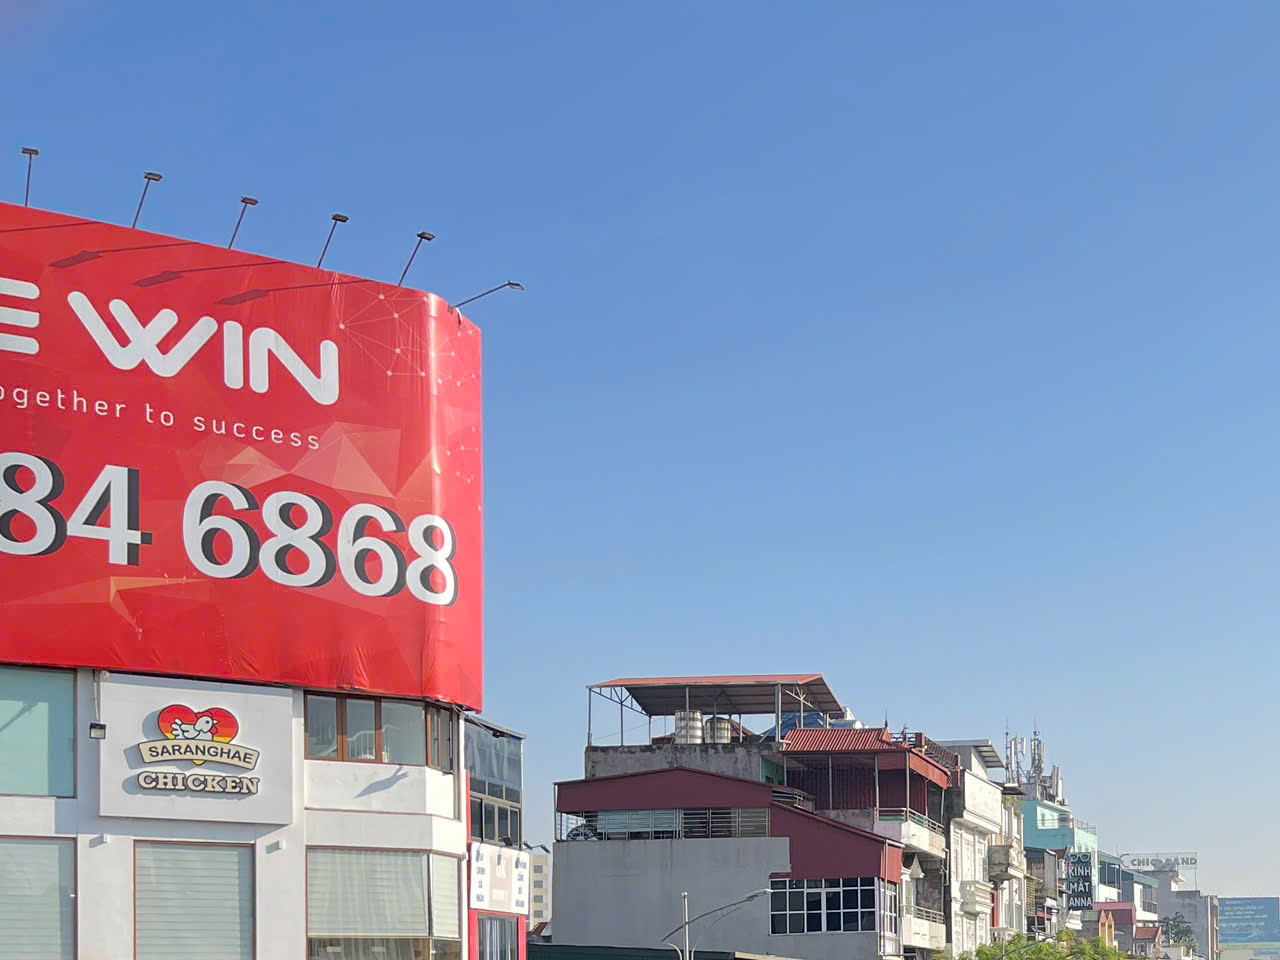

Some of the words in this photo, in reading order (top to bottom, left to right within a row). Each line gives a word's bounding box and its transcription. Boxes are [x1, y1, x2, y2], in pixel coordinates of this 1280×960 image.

[67, 291, 339, 405] WIN
[0, 386, 126, 418] ogether
[145, 403, 174, 426] to
[193, 415, 320, 449] success
[183, 480, 457, 606] 6868
[148, 744, 254, 764] SARANGHAE
[138, 771, 260, 794] CHICKEN
[1068, 865, 1091, 876] KÍNH
[1069, 879, 1090, 892] MẮT
[1069, 896, 1092, 907] ANNA
